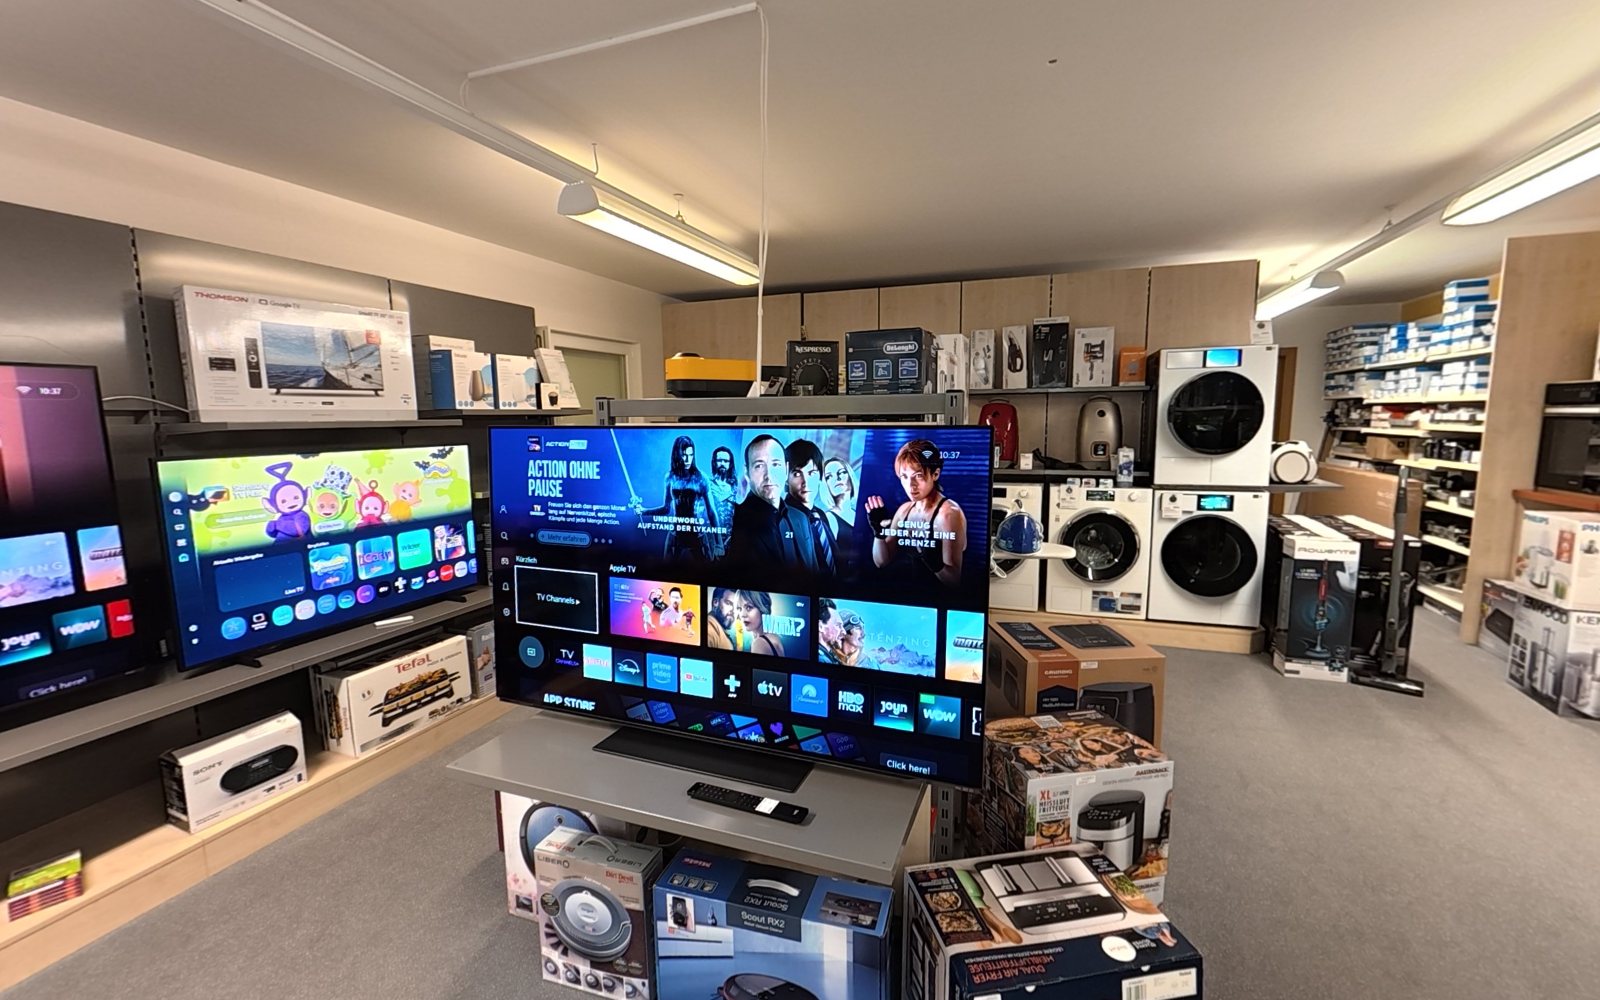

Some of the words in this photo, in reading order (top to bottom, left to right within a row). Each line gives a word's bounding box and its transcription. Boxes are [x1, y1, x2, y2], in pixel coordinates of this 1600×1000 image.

[194, 291, 249, 303] THOMSON
[39, 387, 62, 395] 10:37
[939, 451, 960, 459] 10:37
[528, 460, 567, 478] ACTION
[569, 461, 600, 479] OHNE
[528, 479, 563, 497] PAUSE
[587, 517, 602, 525] Menge
[653, 515, 704, 525] UNDERWORLD
[897, 521, 930, 529] GENUG
[637, 523, 674, 531] AUFSTAND
[693, 526, 727, 534] LYKANER
[880, 528, 909, 537] JEDER
[912, 530, 931, 538] HAT
[933, 531, 956, 540] EINE
[547, 533, 561, 541] Mehr
[563, 534, 587, 543] erfahren
[898, 538, 936, 548] GRENZE
[516, 555, 538, 563] Kürzlich
[609, 564, 627, 573] Apple
[628, 565, 636, 573] TV
[536, 593, 545, 601] TV
[547, 594, 575, 605] Channels
[560, 649, 574, 659] TV
[394, 653, 432, 674] Tefal
[652, 662, 672, 671] prime
[652, 669, 671, 678] video
[29, 685, 56, 698] Click
[838, 690, 864, 704] HBO
[543, 693, 563, 705] APP
[838, 702, 864, 714] max
[880, 701, 908, 715] joyn
[193, 760, 224, 776] SONY
[886, 759, 907, 770] Click
[909, 762, 931, 774] here!
[1040, 789, 1051, 800] XL
[536, 855, 570, 868] LIBERO
[606, 855, 642, 867] LIBERO
[605, 870, 616, 878] Dirt
[618, 873, 634, 882] Devil
[743, 895, 762, 906] RX2
[763, 899, 789, 912] Scout
[741, 911, 765, 924] Scout
[767, 917, 785, 928] RX2
[1003, 968, 1019, 978] AIR
[1019, 964, 1045, 974] DUAL
[972, 971, 1003, 984] FRYER
